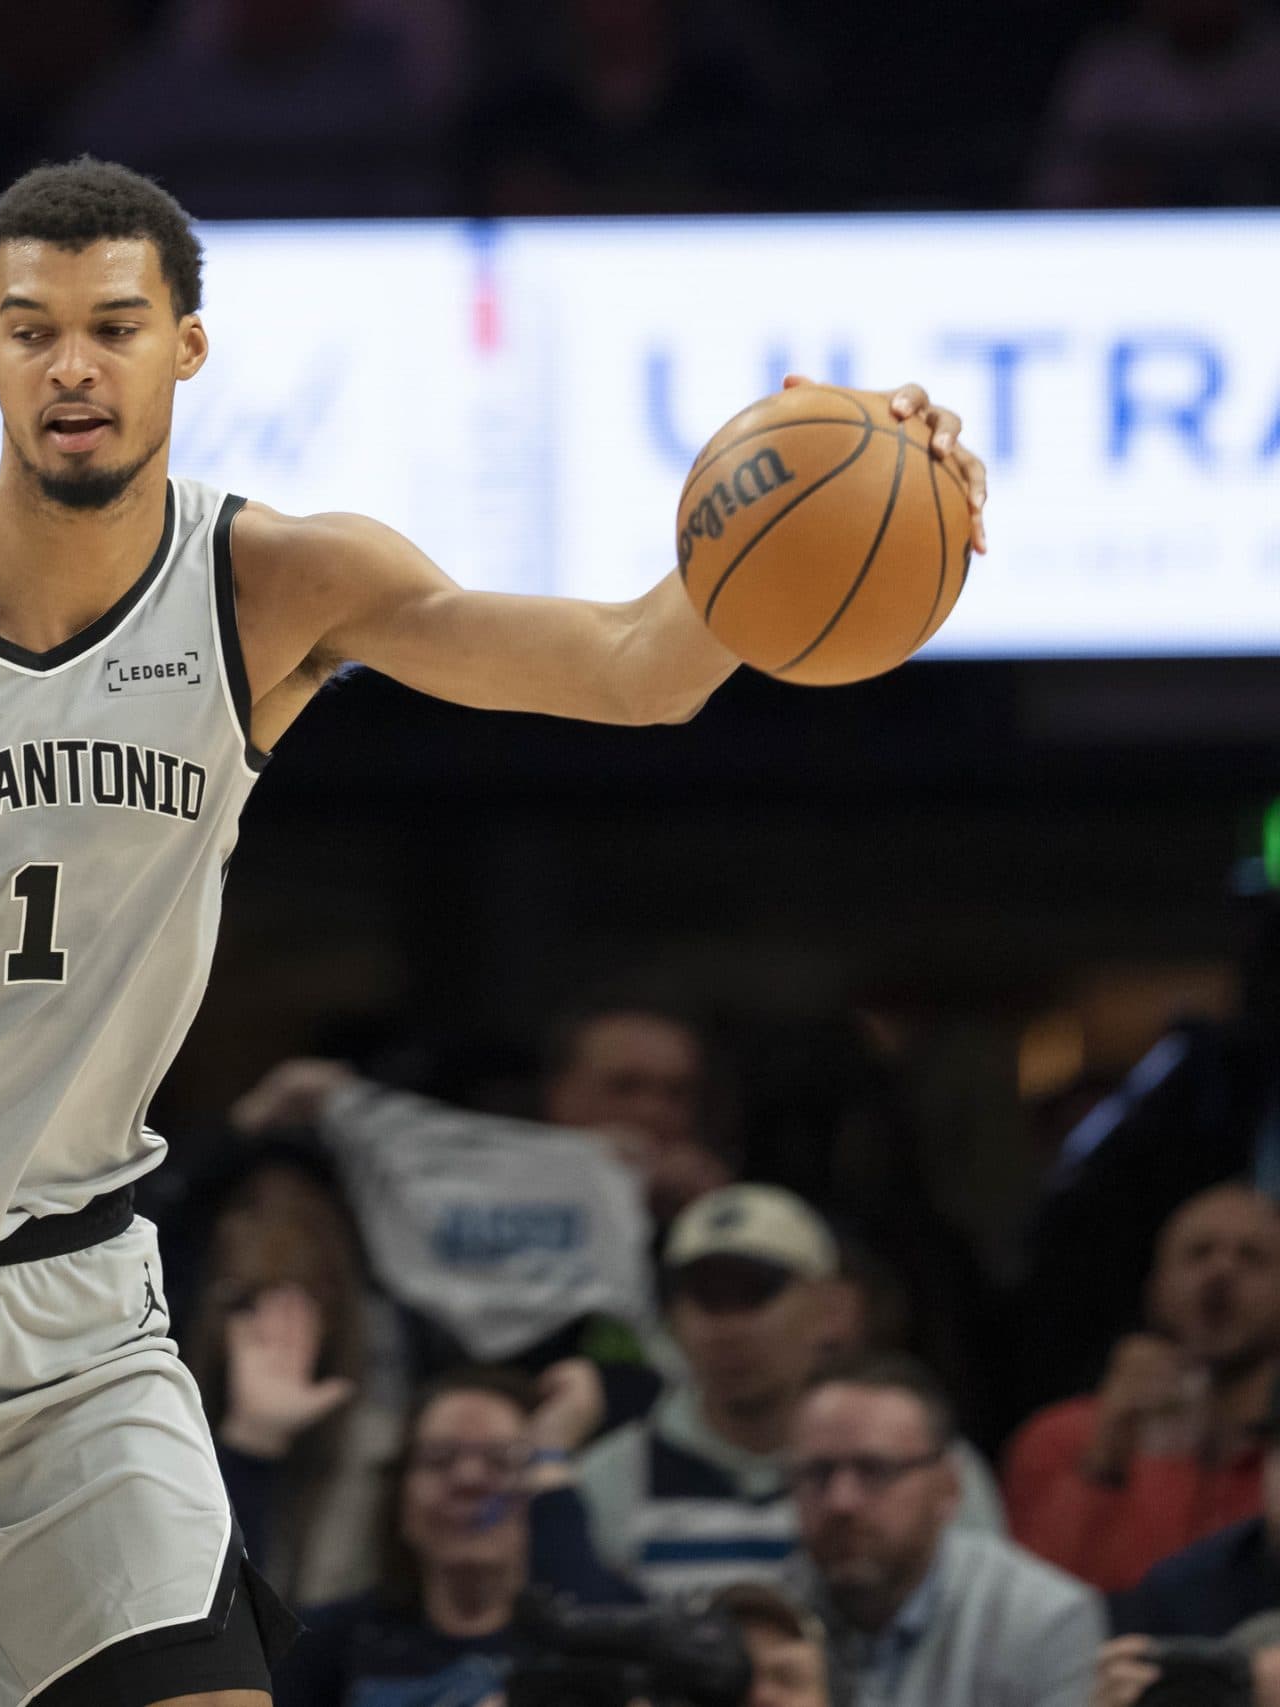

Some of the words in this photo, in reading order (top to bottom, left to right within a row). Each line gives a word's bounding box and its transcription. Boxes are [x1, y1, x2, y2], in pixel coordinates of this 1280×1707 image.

[677, 447, 795, 579] Wilso
[119, 662, 188, 682] LEDGER
[4, 861, 68, 985] 1
